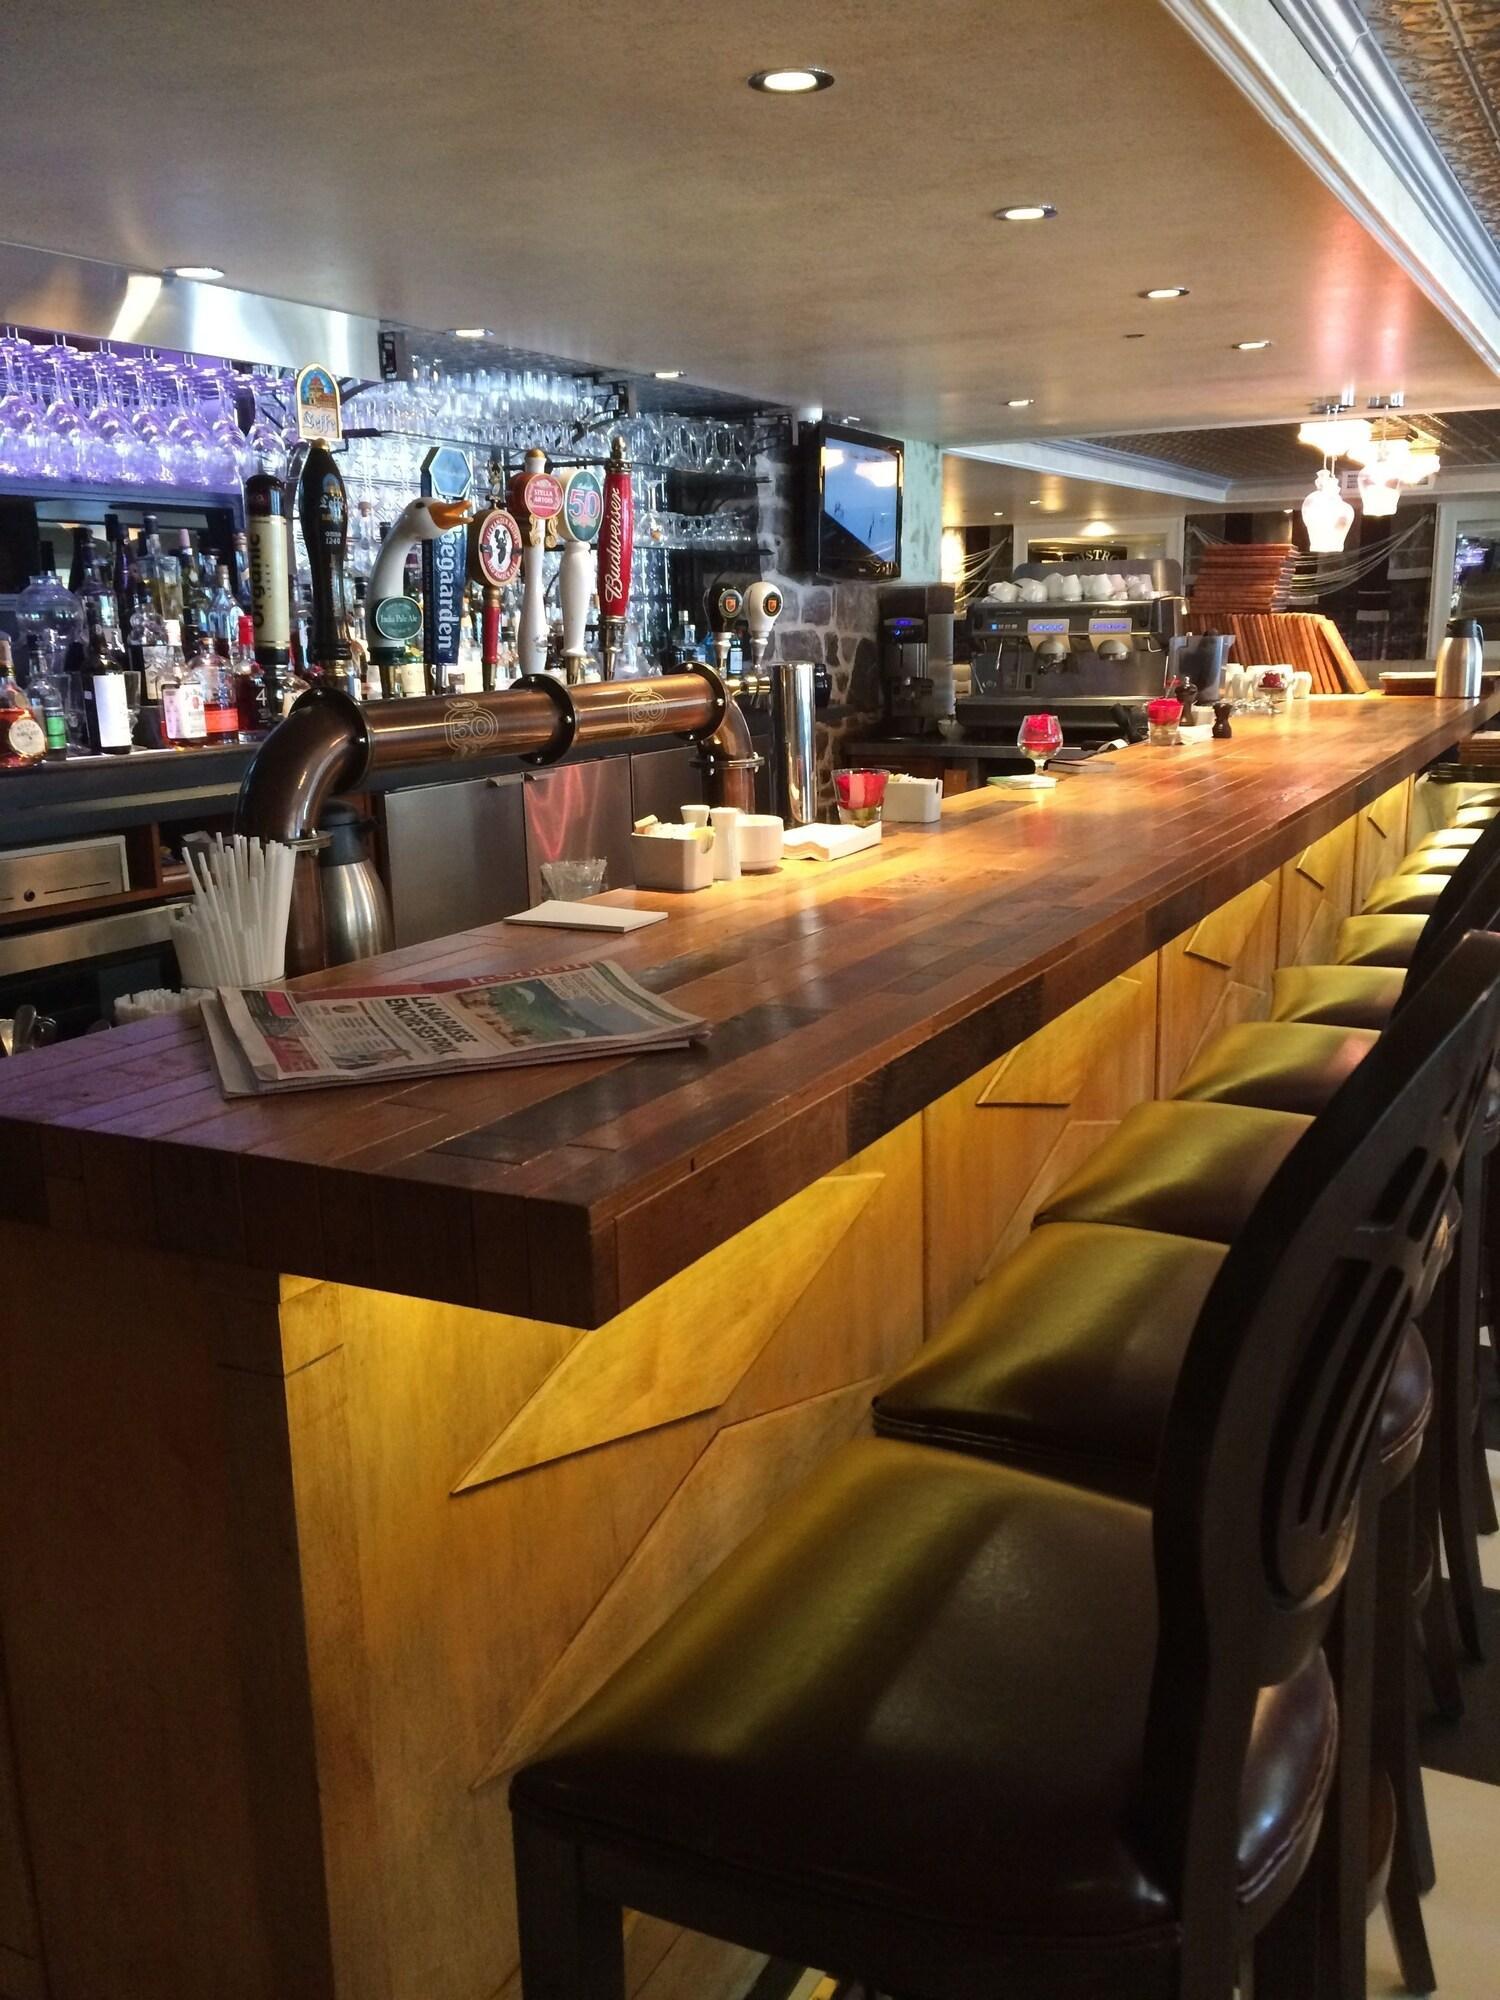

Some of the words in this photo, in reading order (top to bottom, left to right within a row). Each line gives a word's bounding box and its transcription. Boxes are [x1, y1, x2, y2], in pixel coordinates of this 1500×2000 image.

[534, 489, 553, 497] STELLA
[569, 488, 600, 518] 50
[605, 487, 622, 602] Budweiser
[380, 614, 395, 622] India
[395, 614, 407, 622] Pale
[452, 716, 491, 741] 50
[411, 996, 436, 1008] LA
